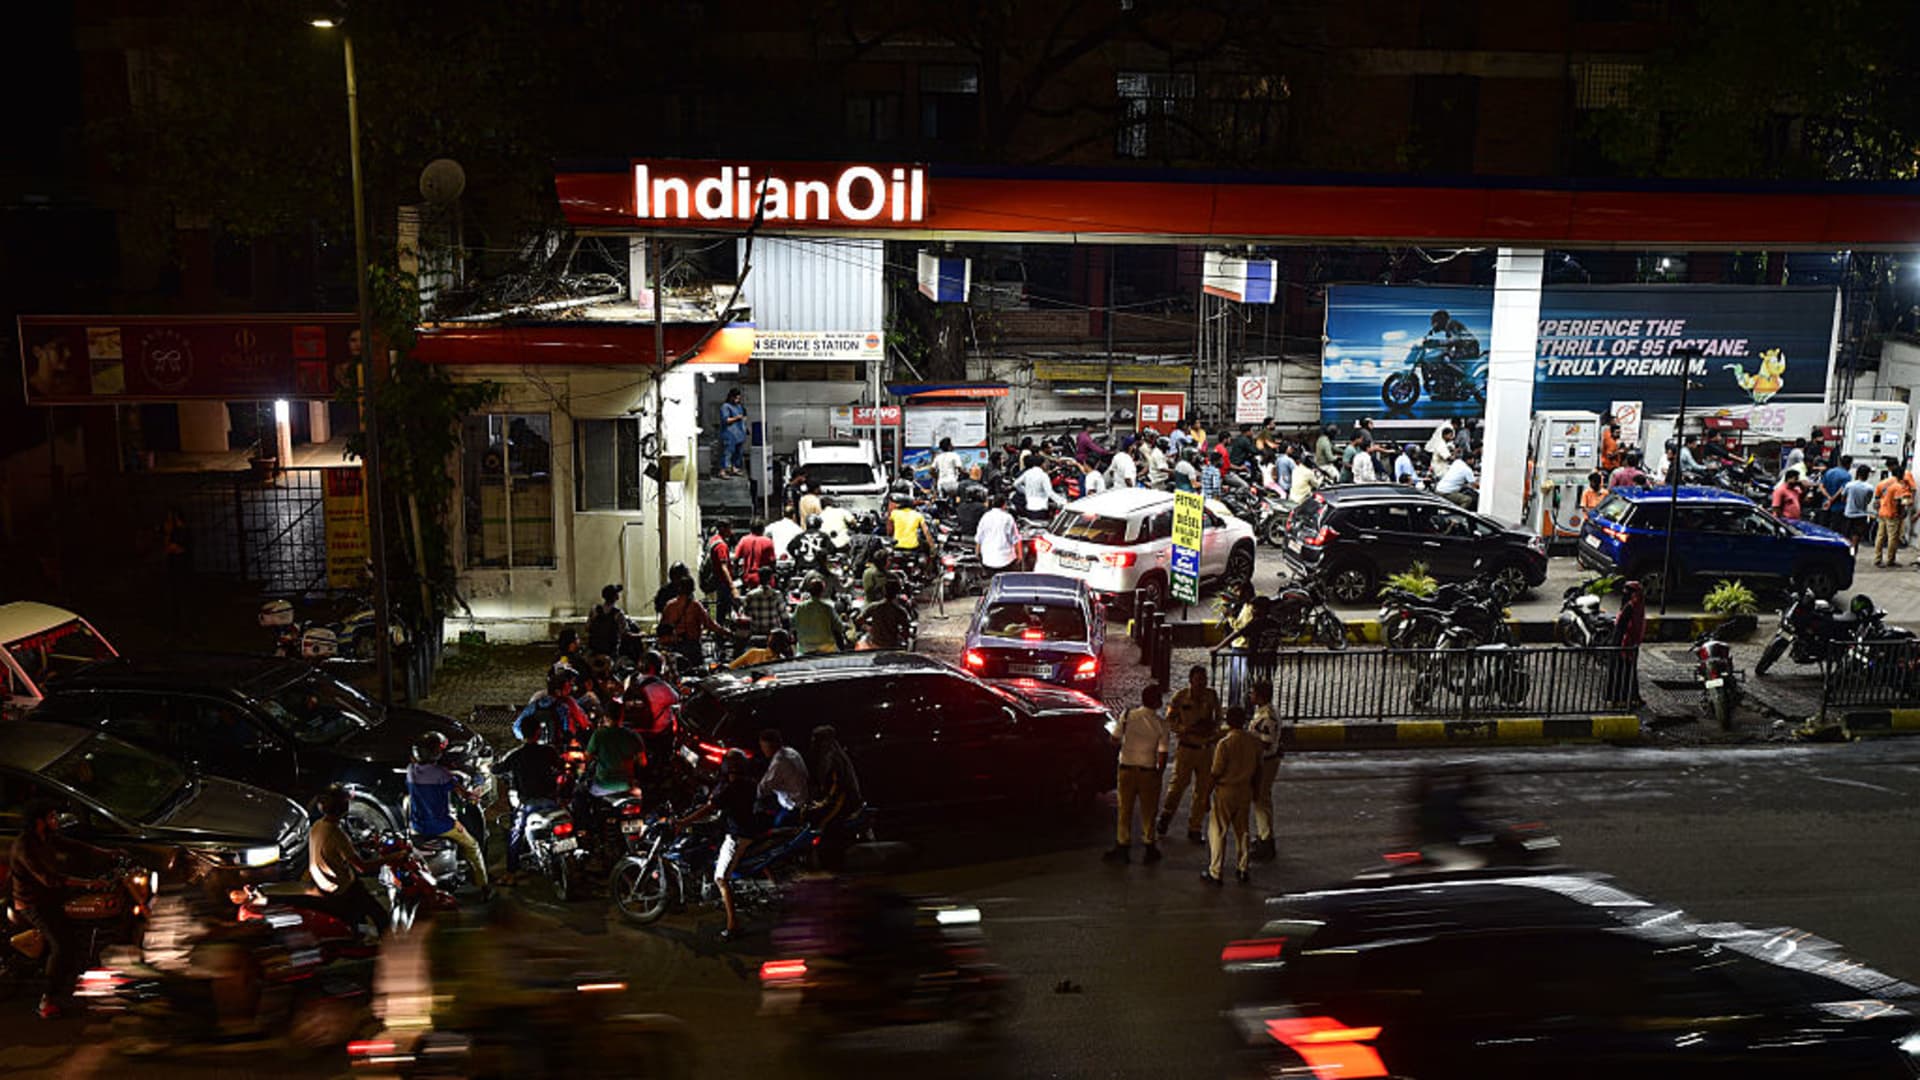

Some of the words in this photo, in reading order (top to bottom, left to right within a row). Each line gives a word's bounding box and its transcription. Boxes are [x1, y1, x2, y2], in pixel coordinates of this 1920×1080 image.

[635, 164, 924, 222] IndianOil
[1645, 320, 1686, 336] THE
[763, 339, 810, 351] SERVICE
[813, 340, 859, 351] STATION
[1540, 338, 1608, 356] THRILL
[1611, 339, 1638, 356] OF
[1640, 339, 1666, 356] 95
[1547, 359, 1612, 376] TRULY
[1175, 494, 1200, 510] PETROL
[1177, 513, 1200, 529] DIESEL
